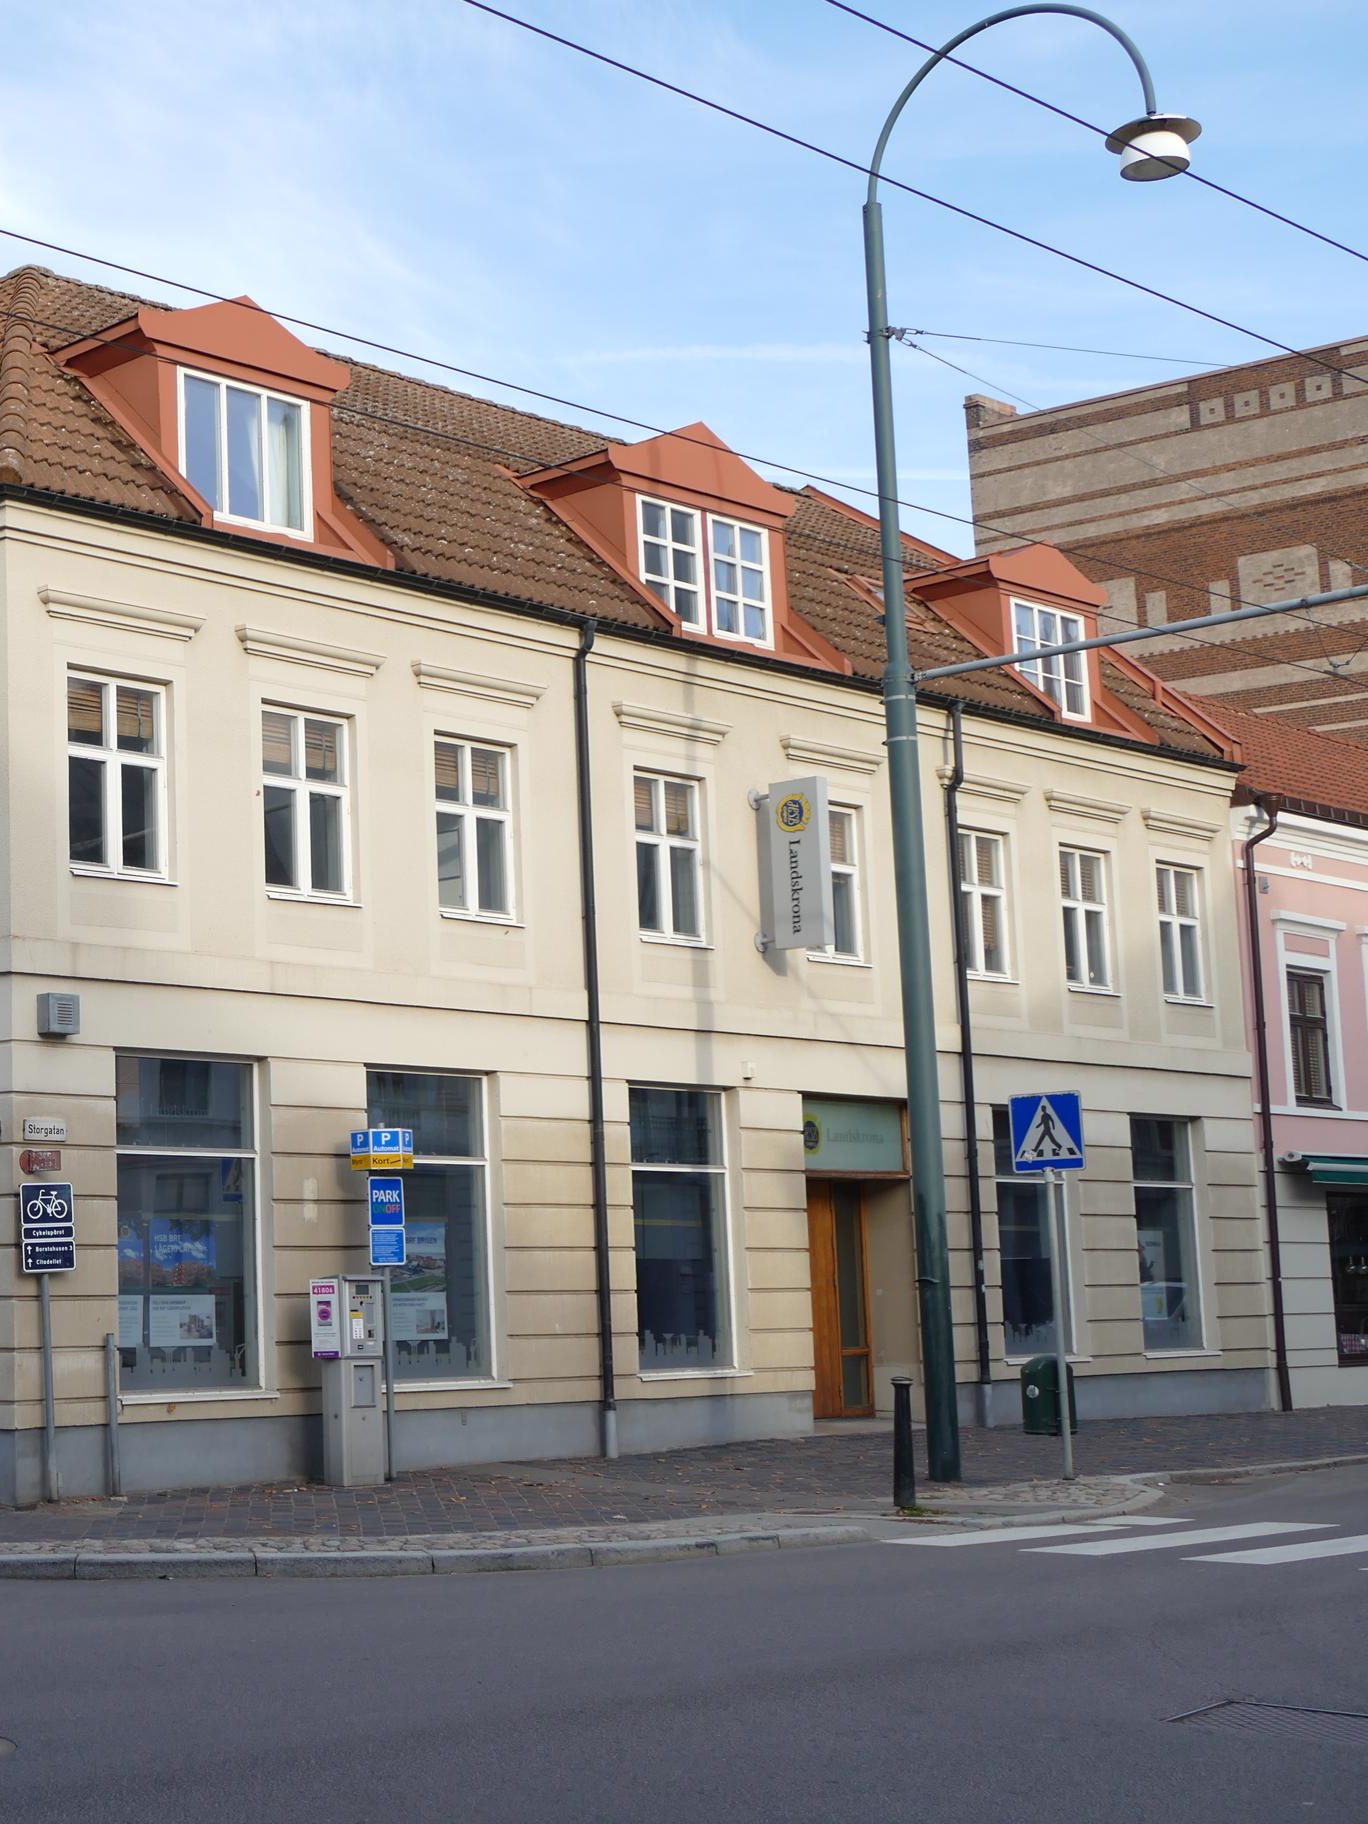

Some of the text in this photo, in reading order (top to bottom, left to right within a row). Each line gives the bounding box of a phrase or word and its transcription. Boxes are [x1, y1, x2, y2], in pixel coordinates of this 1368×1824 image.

[788, 839, 803, 935] Landskrona
[28, 1123, 65, 1138] Storgatan
[825, 1127, 885, 1145] Landskrona
[357, 1134, 364, 1146] P
[381, 1132, 392, 1145] P
[404, 1133, 410, 1145] P
[372, 1157, 390, 1165] Kort
[372, 1189, 401, 1203] PARK
